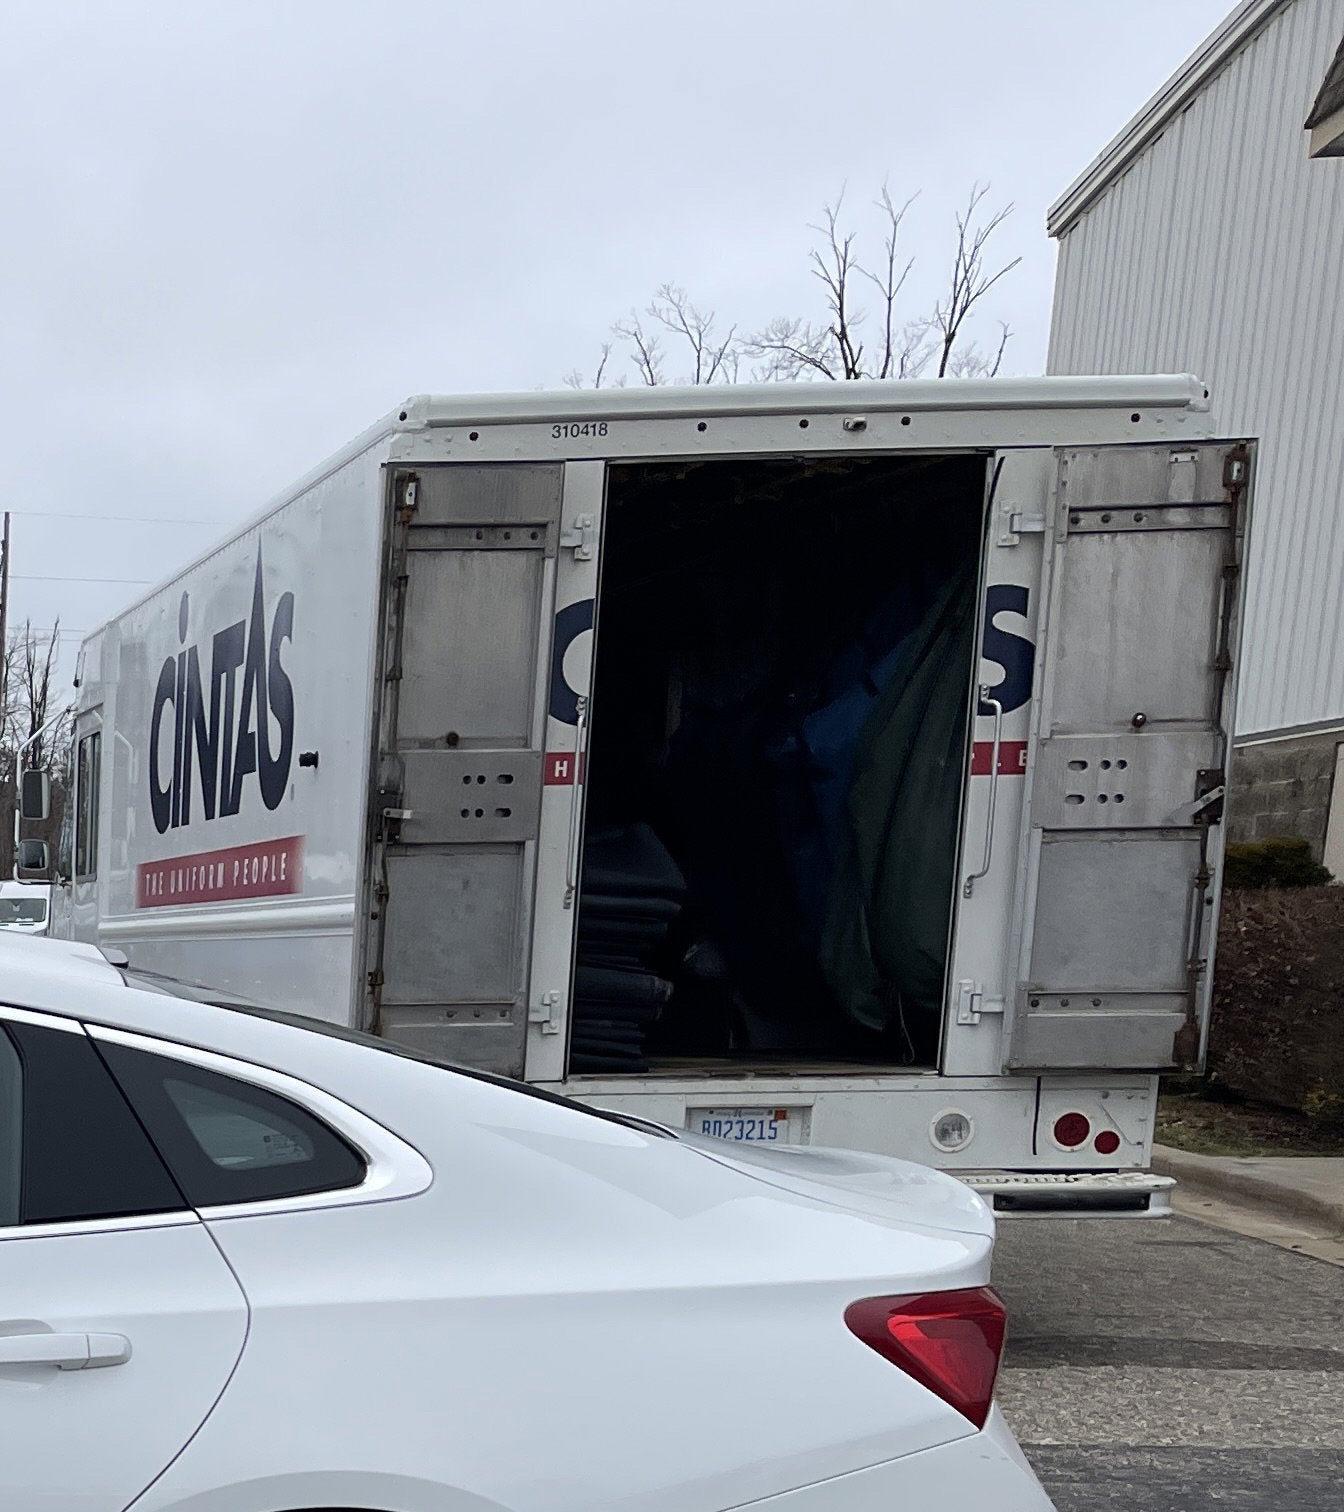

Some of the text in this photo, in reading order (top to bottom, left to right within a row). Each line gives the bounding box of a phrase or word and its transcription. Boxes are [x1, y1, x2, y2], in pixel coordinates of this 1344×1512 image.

[551, 422, 608, 439] 310418
[146, 852, 287, 897] THE UNIFORM PEOPLE
